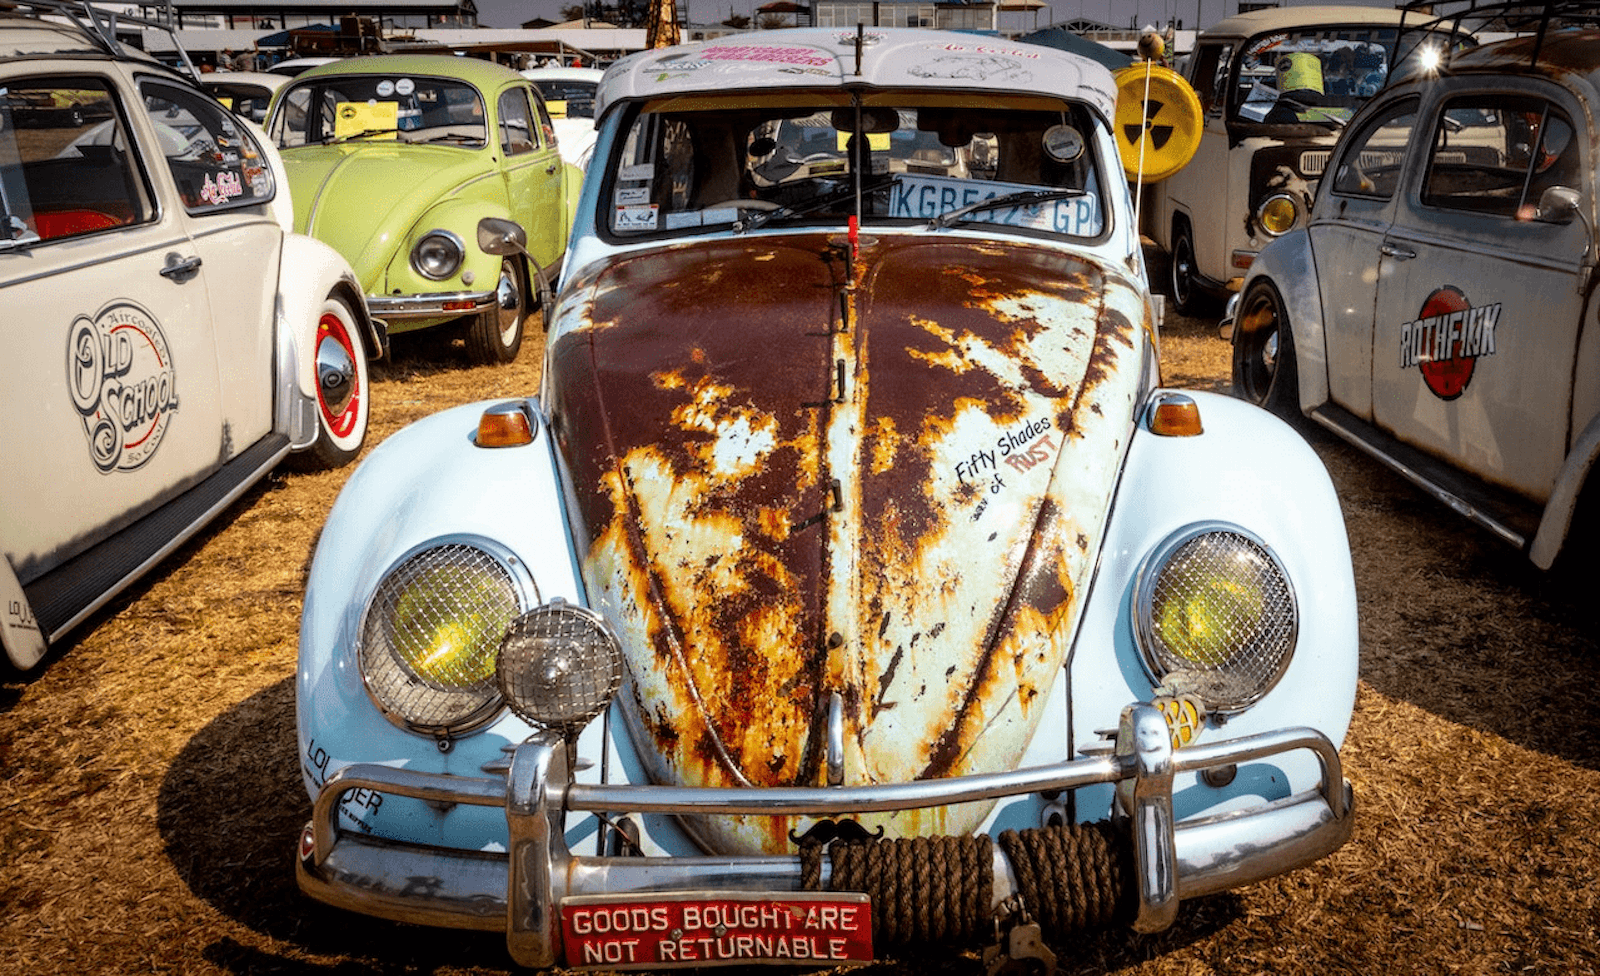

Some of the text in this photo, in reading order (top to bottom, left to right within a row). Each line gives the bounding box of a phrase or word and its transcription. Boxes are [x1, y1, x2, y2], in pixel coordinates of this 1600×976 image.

[1054, 199, 1090, 234] GP
[955, 417, 1051, 484] Fifty Shades
[991, 434, 1058, 494] of RUST
[573, 905, 859, 934] GOODS BOUGHT ARE
[584, 934, 849, 963] NOT RETURNABLE
